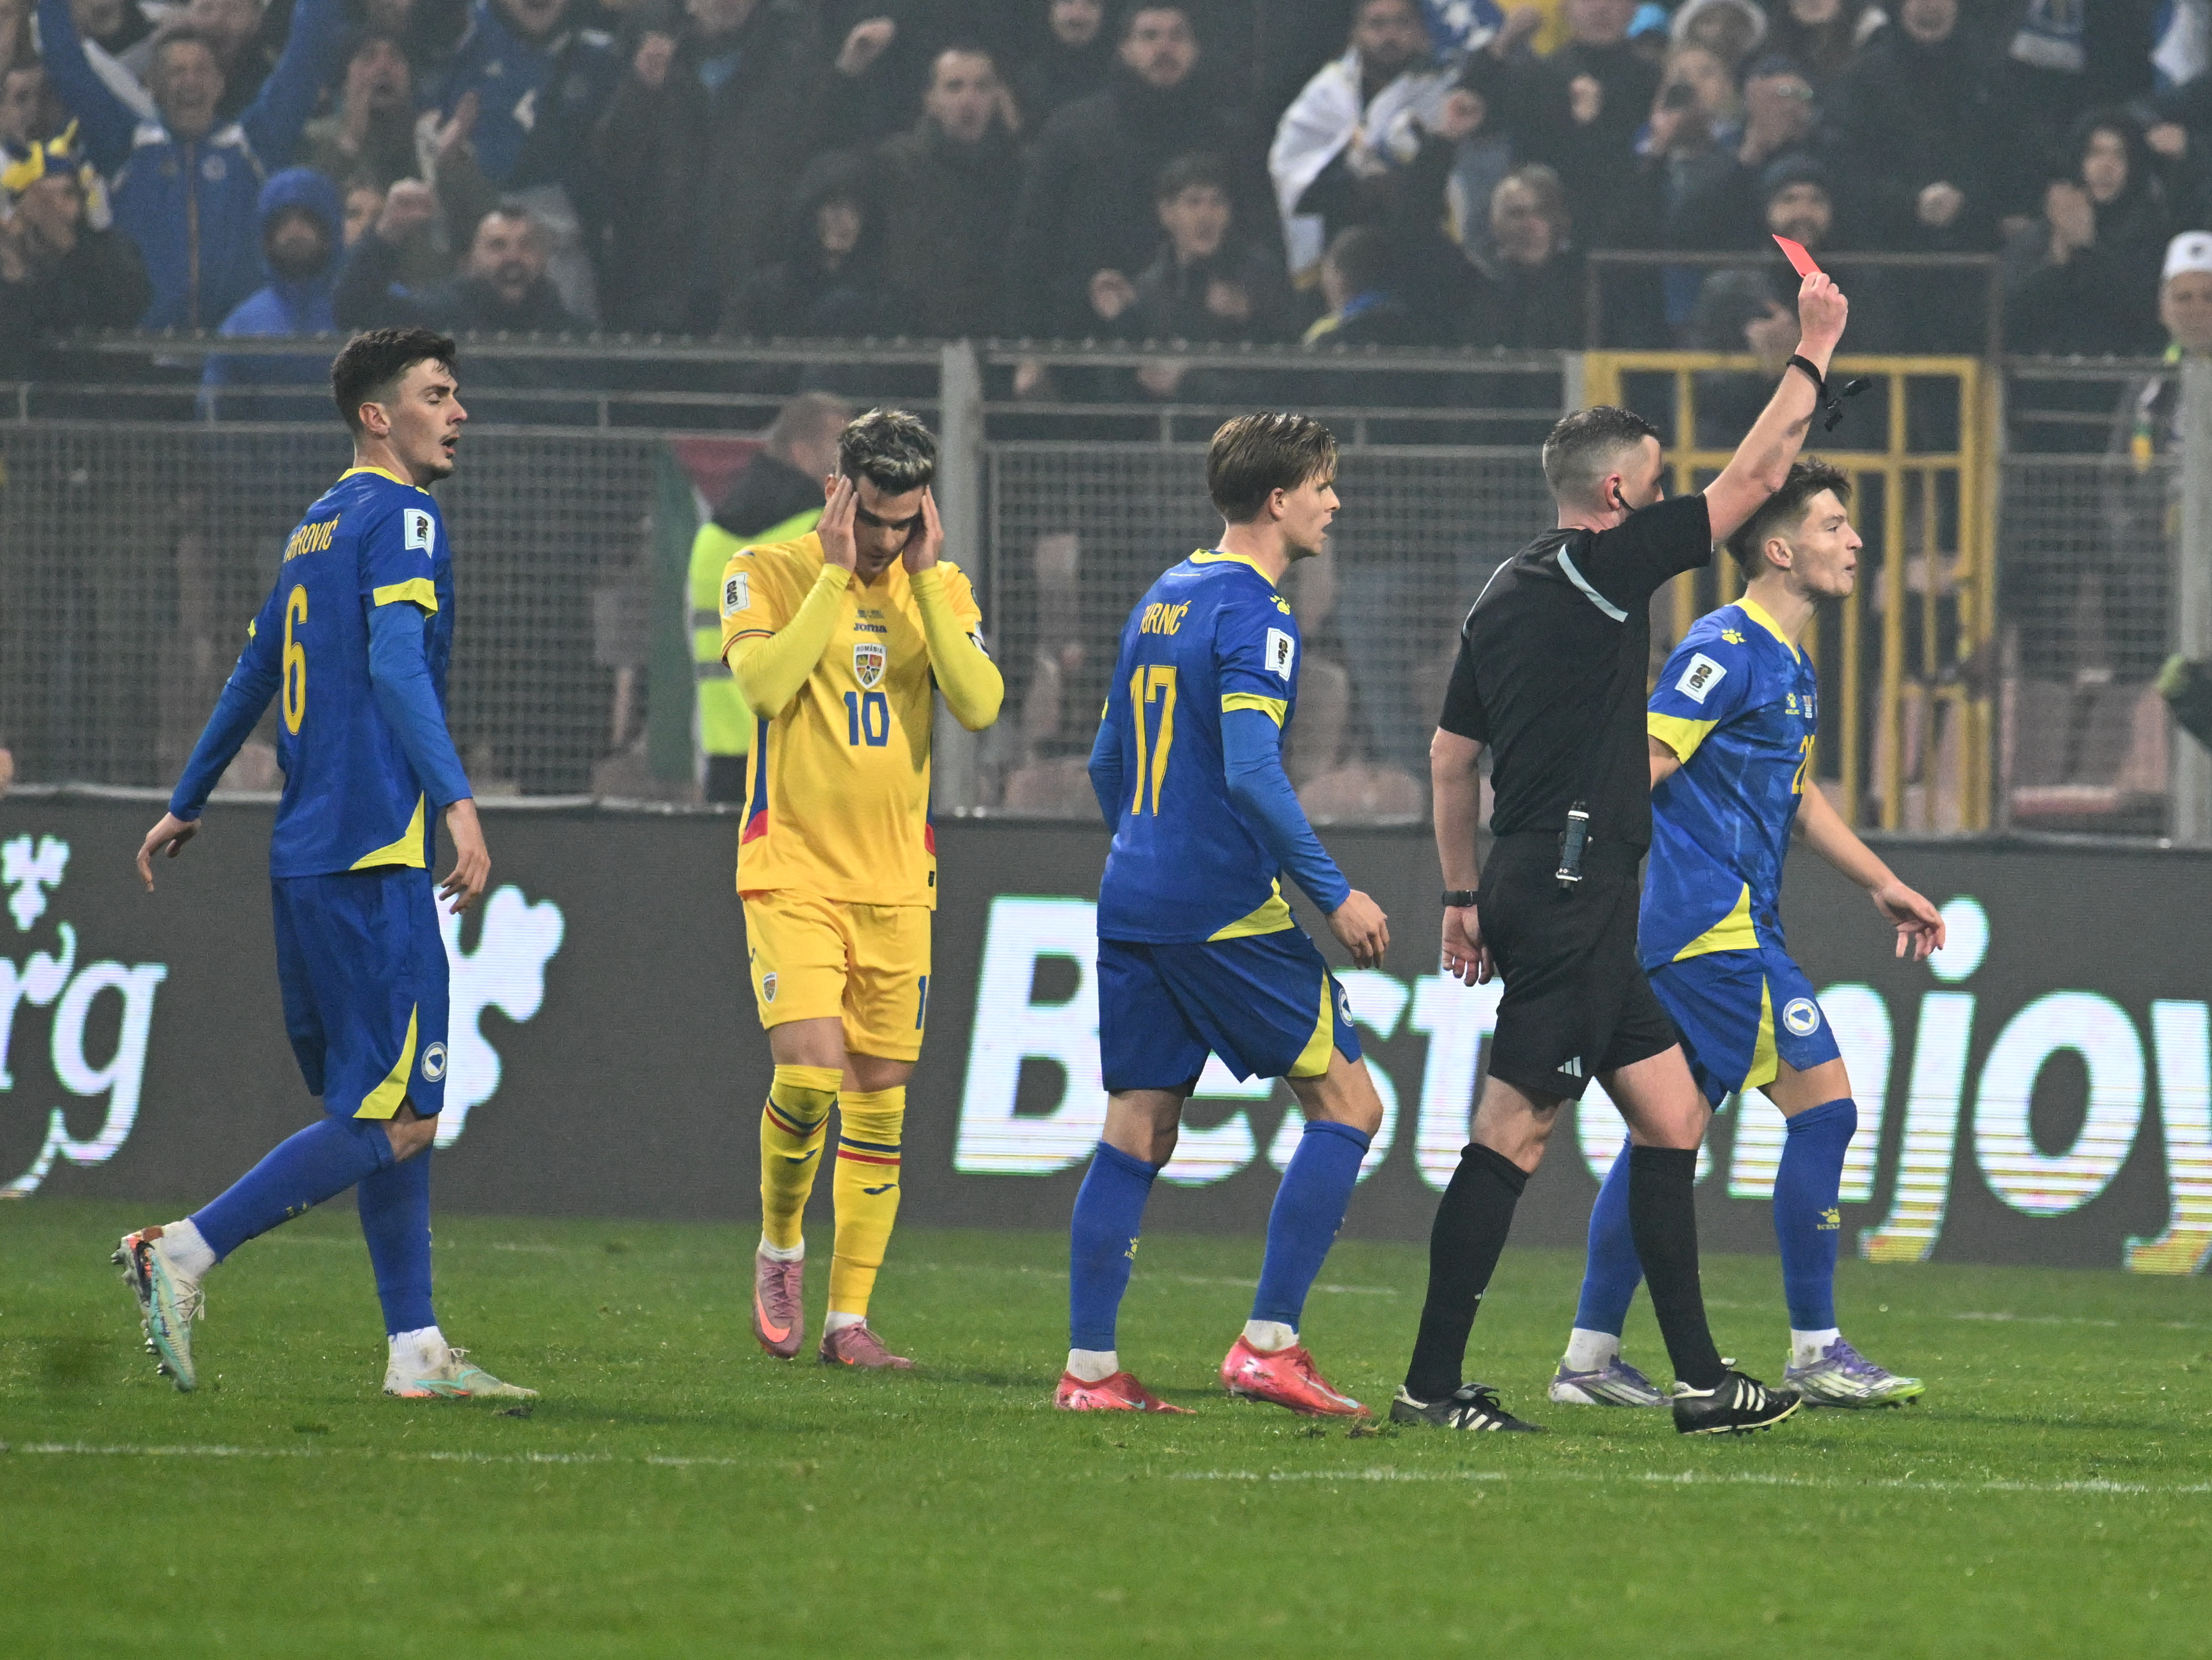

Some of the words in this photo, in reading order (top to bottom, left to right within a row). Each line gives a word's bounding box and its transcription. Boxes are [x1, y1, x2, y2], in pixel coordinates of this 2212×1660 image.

[282, 584, 307, 735] 6
[844, 691, 890, 747] 10
[1130, 664, 1177, 816] 17
